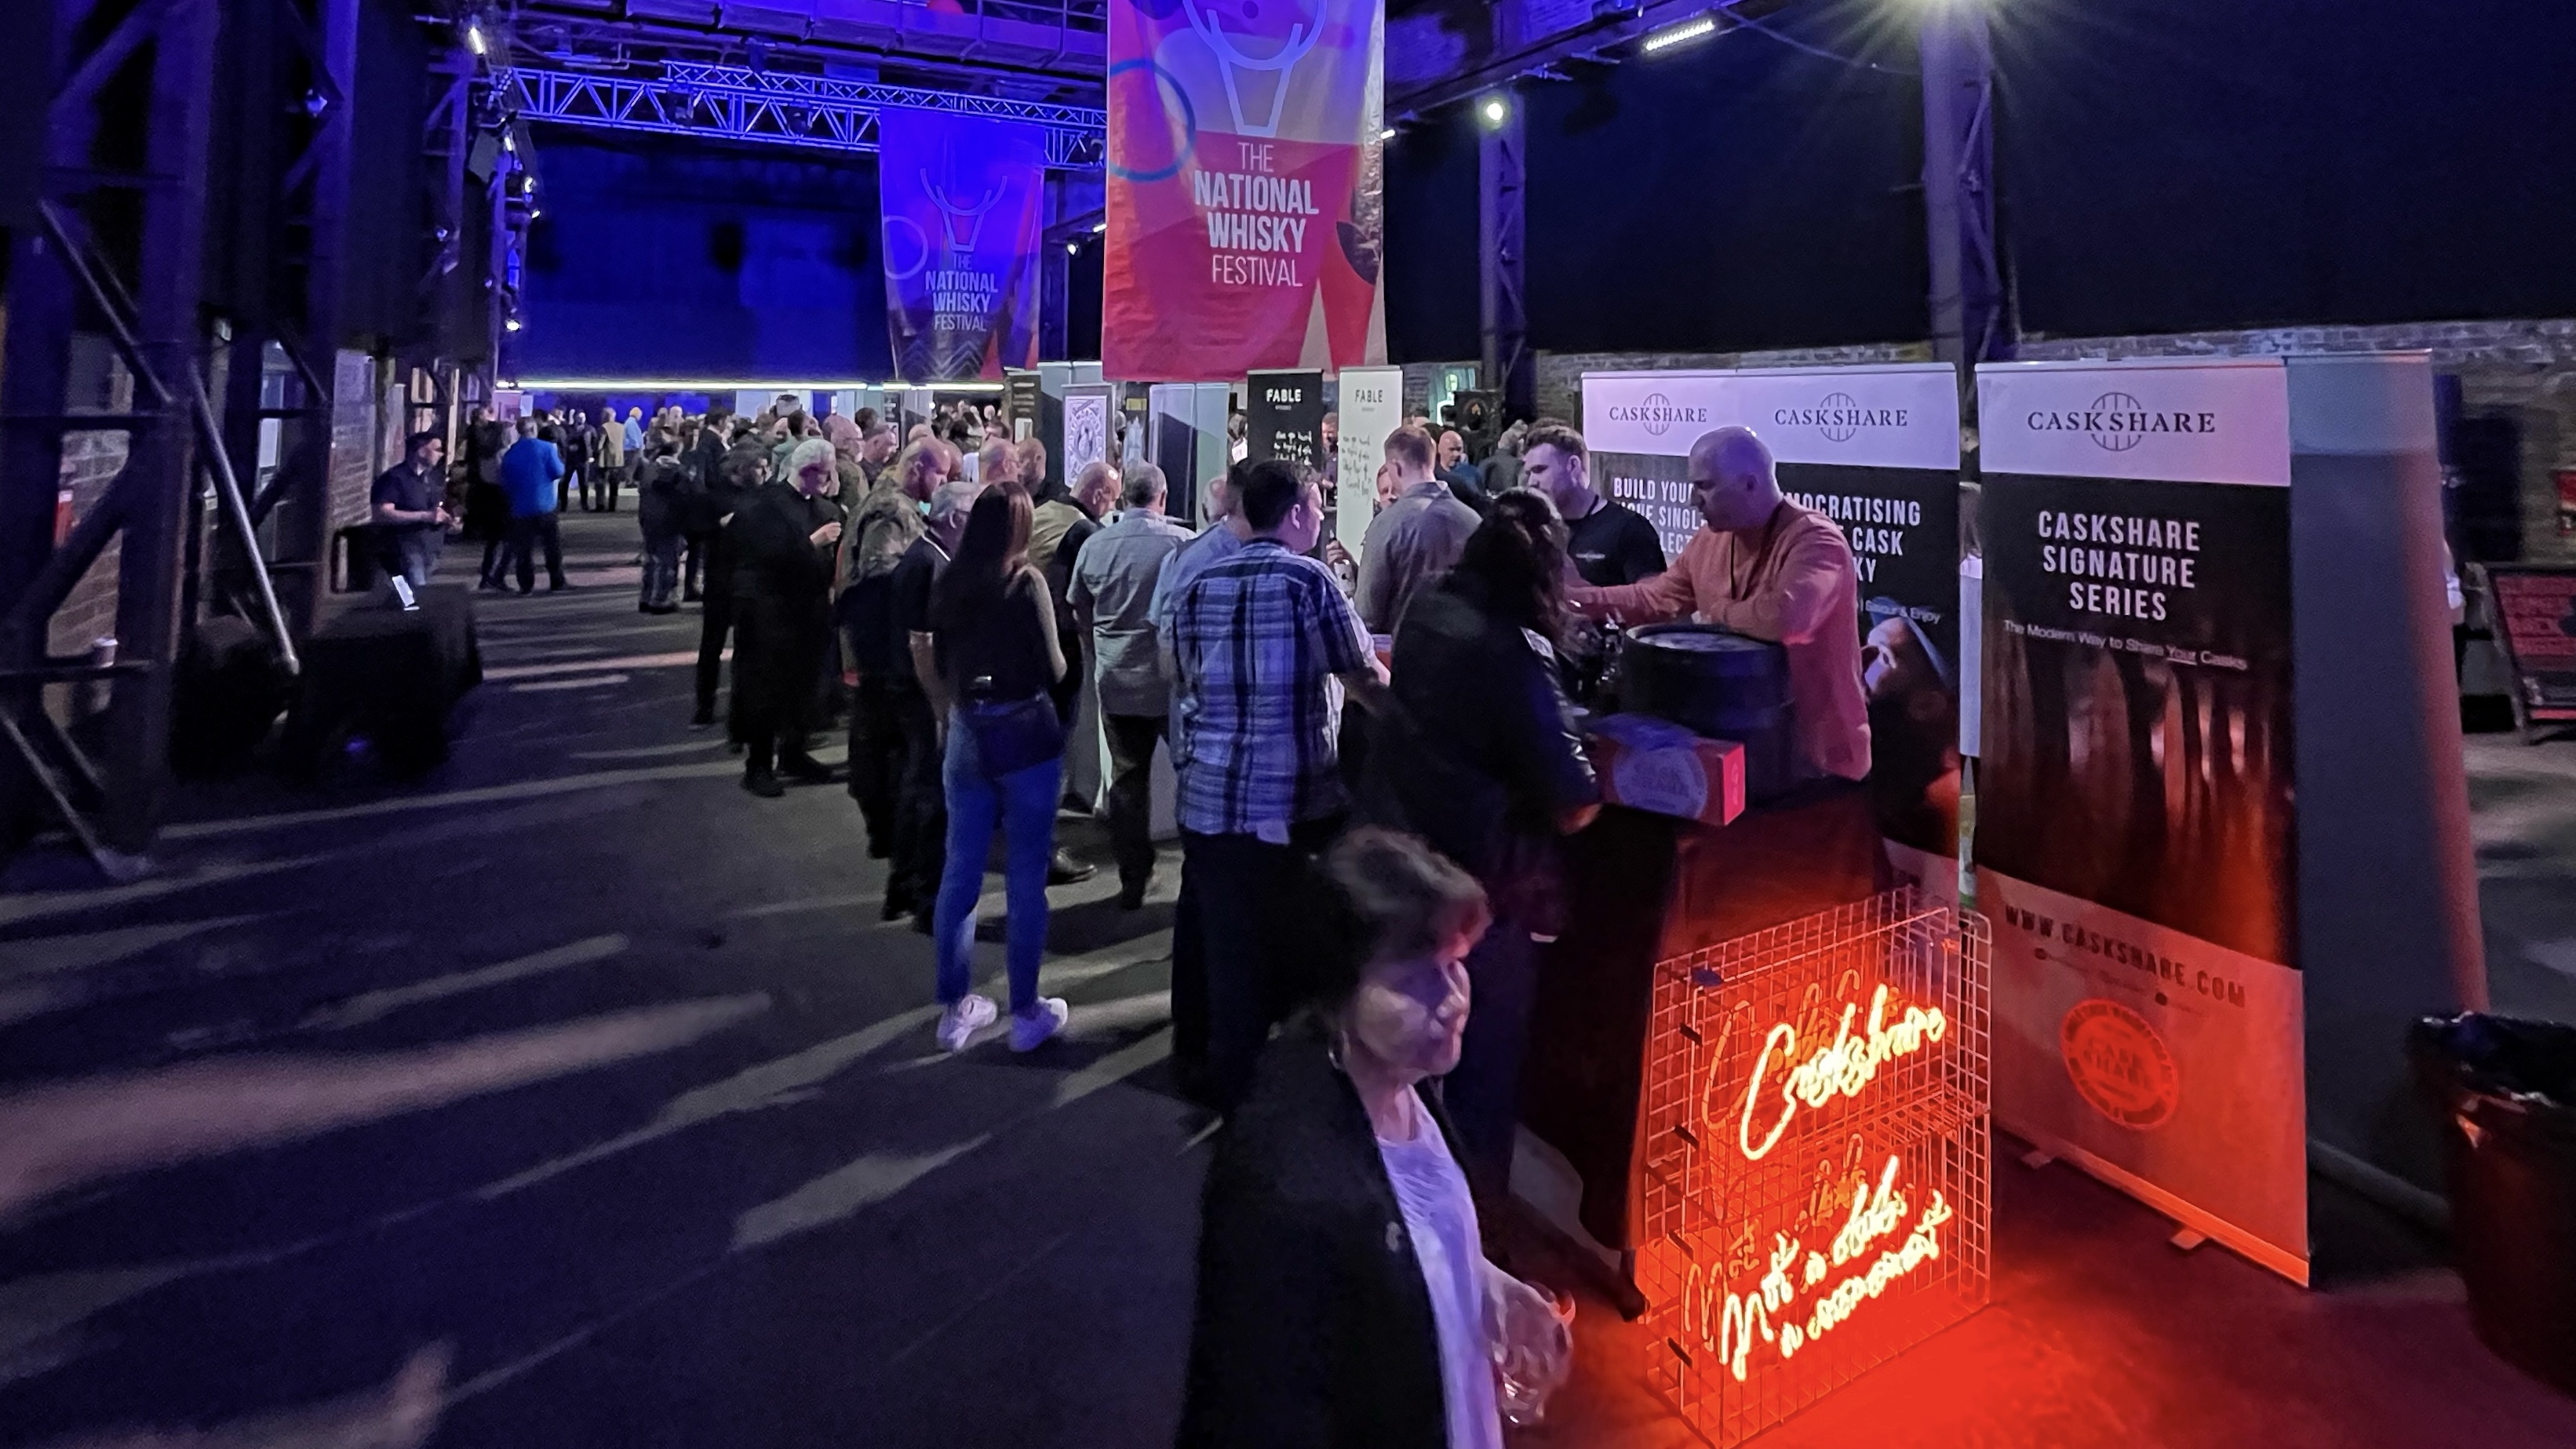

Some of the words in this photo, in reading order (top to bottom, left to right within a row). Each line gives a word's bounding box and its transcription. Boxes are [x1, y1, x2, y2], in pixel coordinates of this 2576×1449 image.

[1237, 142, 1274, 173] THE
[1194, 170, 1320, 214] NATIONAL
[1208, 212, 1306, 253] WHISKY
[953, 253, 973, 271] THE
[1212, 254, 1303, 287] FESTIVAL
[925, 270, 999, 293] NATIONAL
[932, 291, 991, 313] WHISKY
[935, 314, 987, 332] FESTIVAL
[1266, 388, 1302, 402] FABLE
[1355, 389, 1383, 402] FABLE
[1609, 406, 1707, 423] CASKSHARE
[1775, 409, 1907, 427] CASKSHARE
[2028, 411, 2216, 433] CASKSHARE
[1613, 477, 1656, 500] BUILD
[1658, 505, 1703, 530] SINGL
[1786, 492, 1921, 526] OCRATISING
[1853, 526, 1904, 555] CASK
[2039, 511, 2200, 551] CASKSHARE
[2042, 545, 2195, 588] SIGNATURE
[2069, 581, 2166, 621] SERIES
[2003, 620, 2025, 635] The
[2027, 624, 2075, 643] Modern
[2079, 631, 2106, 649] Way
[2109, 636, 2123, 650] to
[2126, 638, 2164, 657] Share
[2166, 644, 2196, 661] Your
[2200, 650, 2248, 671] Casks
